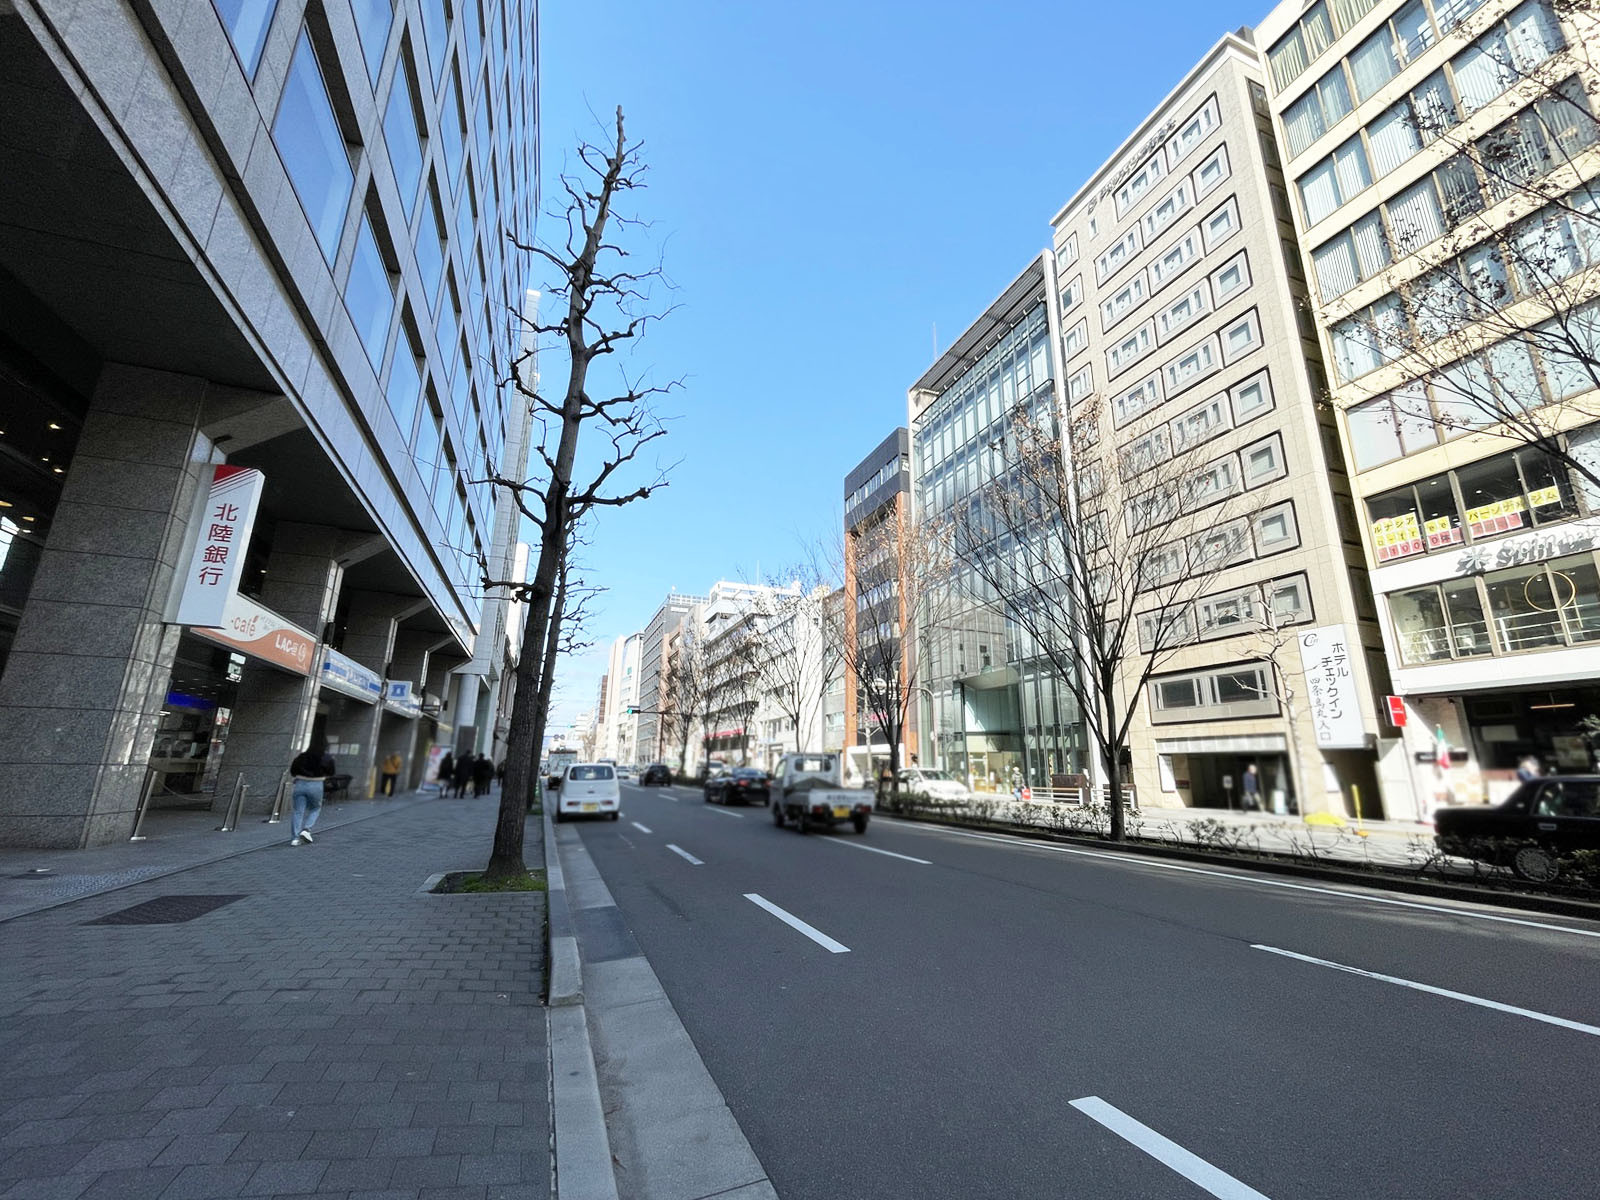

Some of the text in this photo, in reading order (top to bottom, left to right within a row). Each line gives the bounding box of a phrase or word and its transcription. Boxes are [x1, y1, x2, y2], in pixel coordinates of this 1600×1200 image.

[199, 503, 239, 585] 北陸銀行
[1321, 656, 1343, 719] チェックイン
[1332, 643, 1349, 677] ホテル
